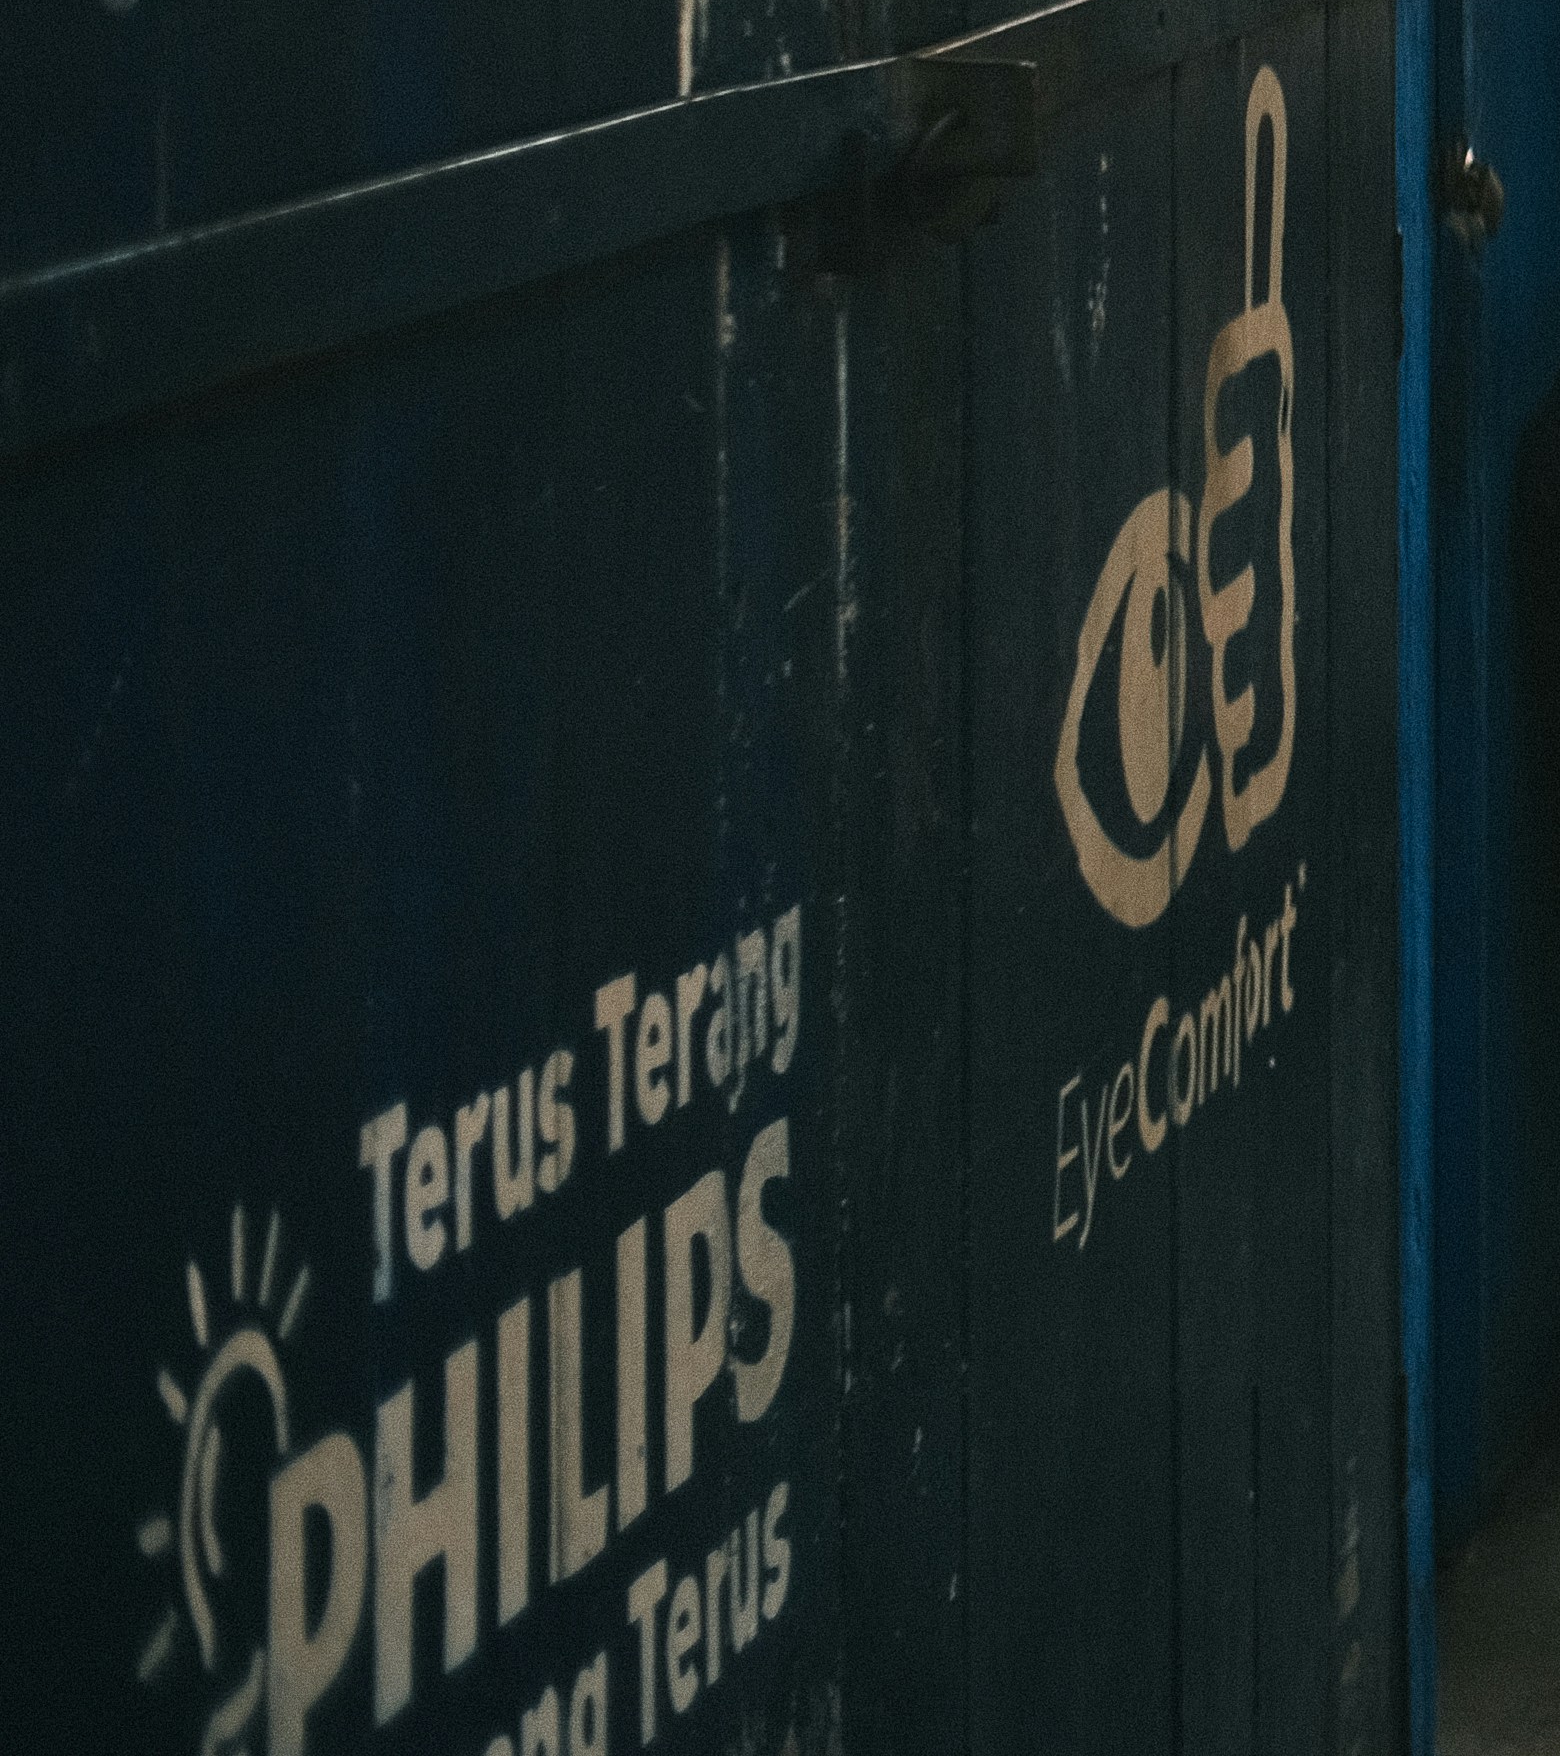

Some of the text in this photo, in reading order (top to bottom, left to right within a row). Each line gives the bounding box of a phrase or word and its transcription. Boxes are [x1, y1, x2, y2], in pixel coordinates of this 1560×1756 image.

[360, 903, 800, 1305] Terus Terang
[1050, 874, 1298, 1254] EyeComfort
[267, 1116, 797, 1756] PHILIPS
[627, 1479, 791, 1746] Terus
